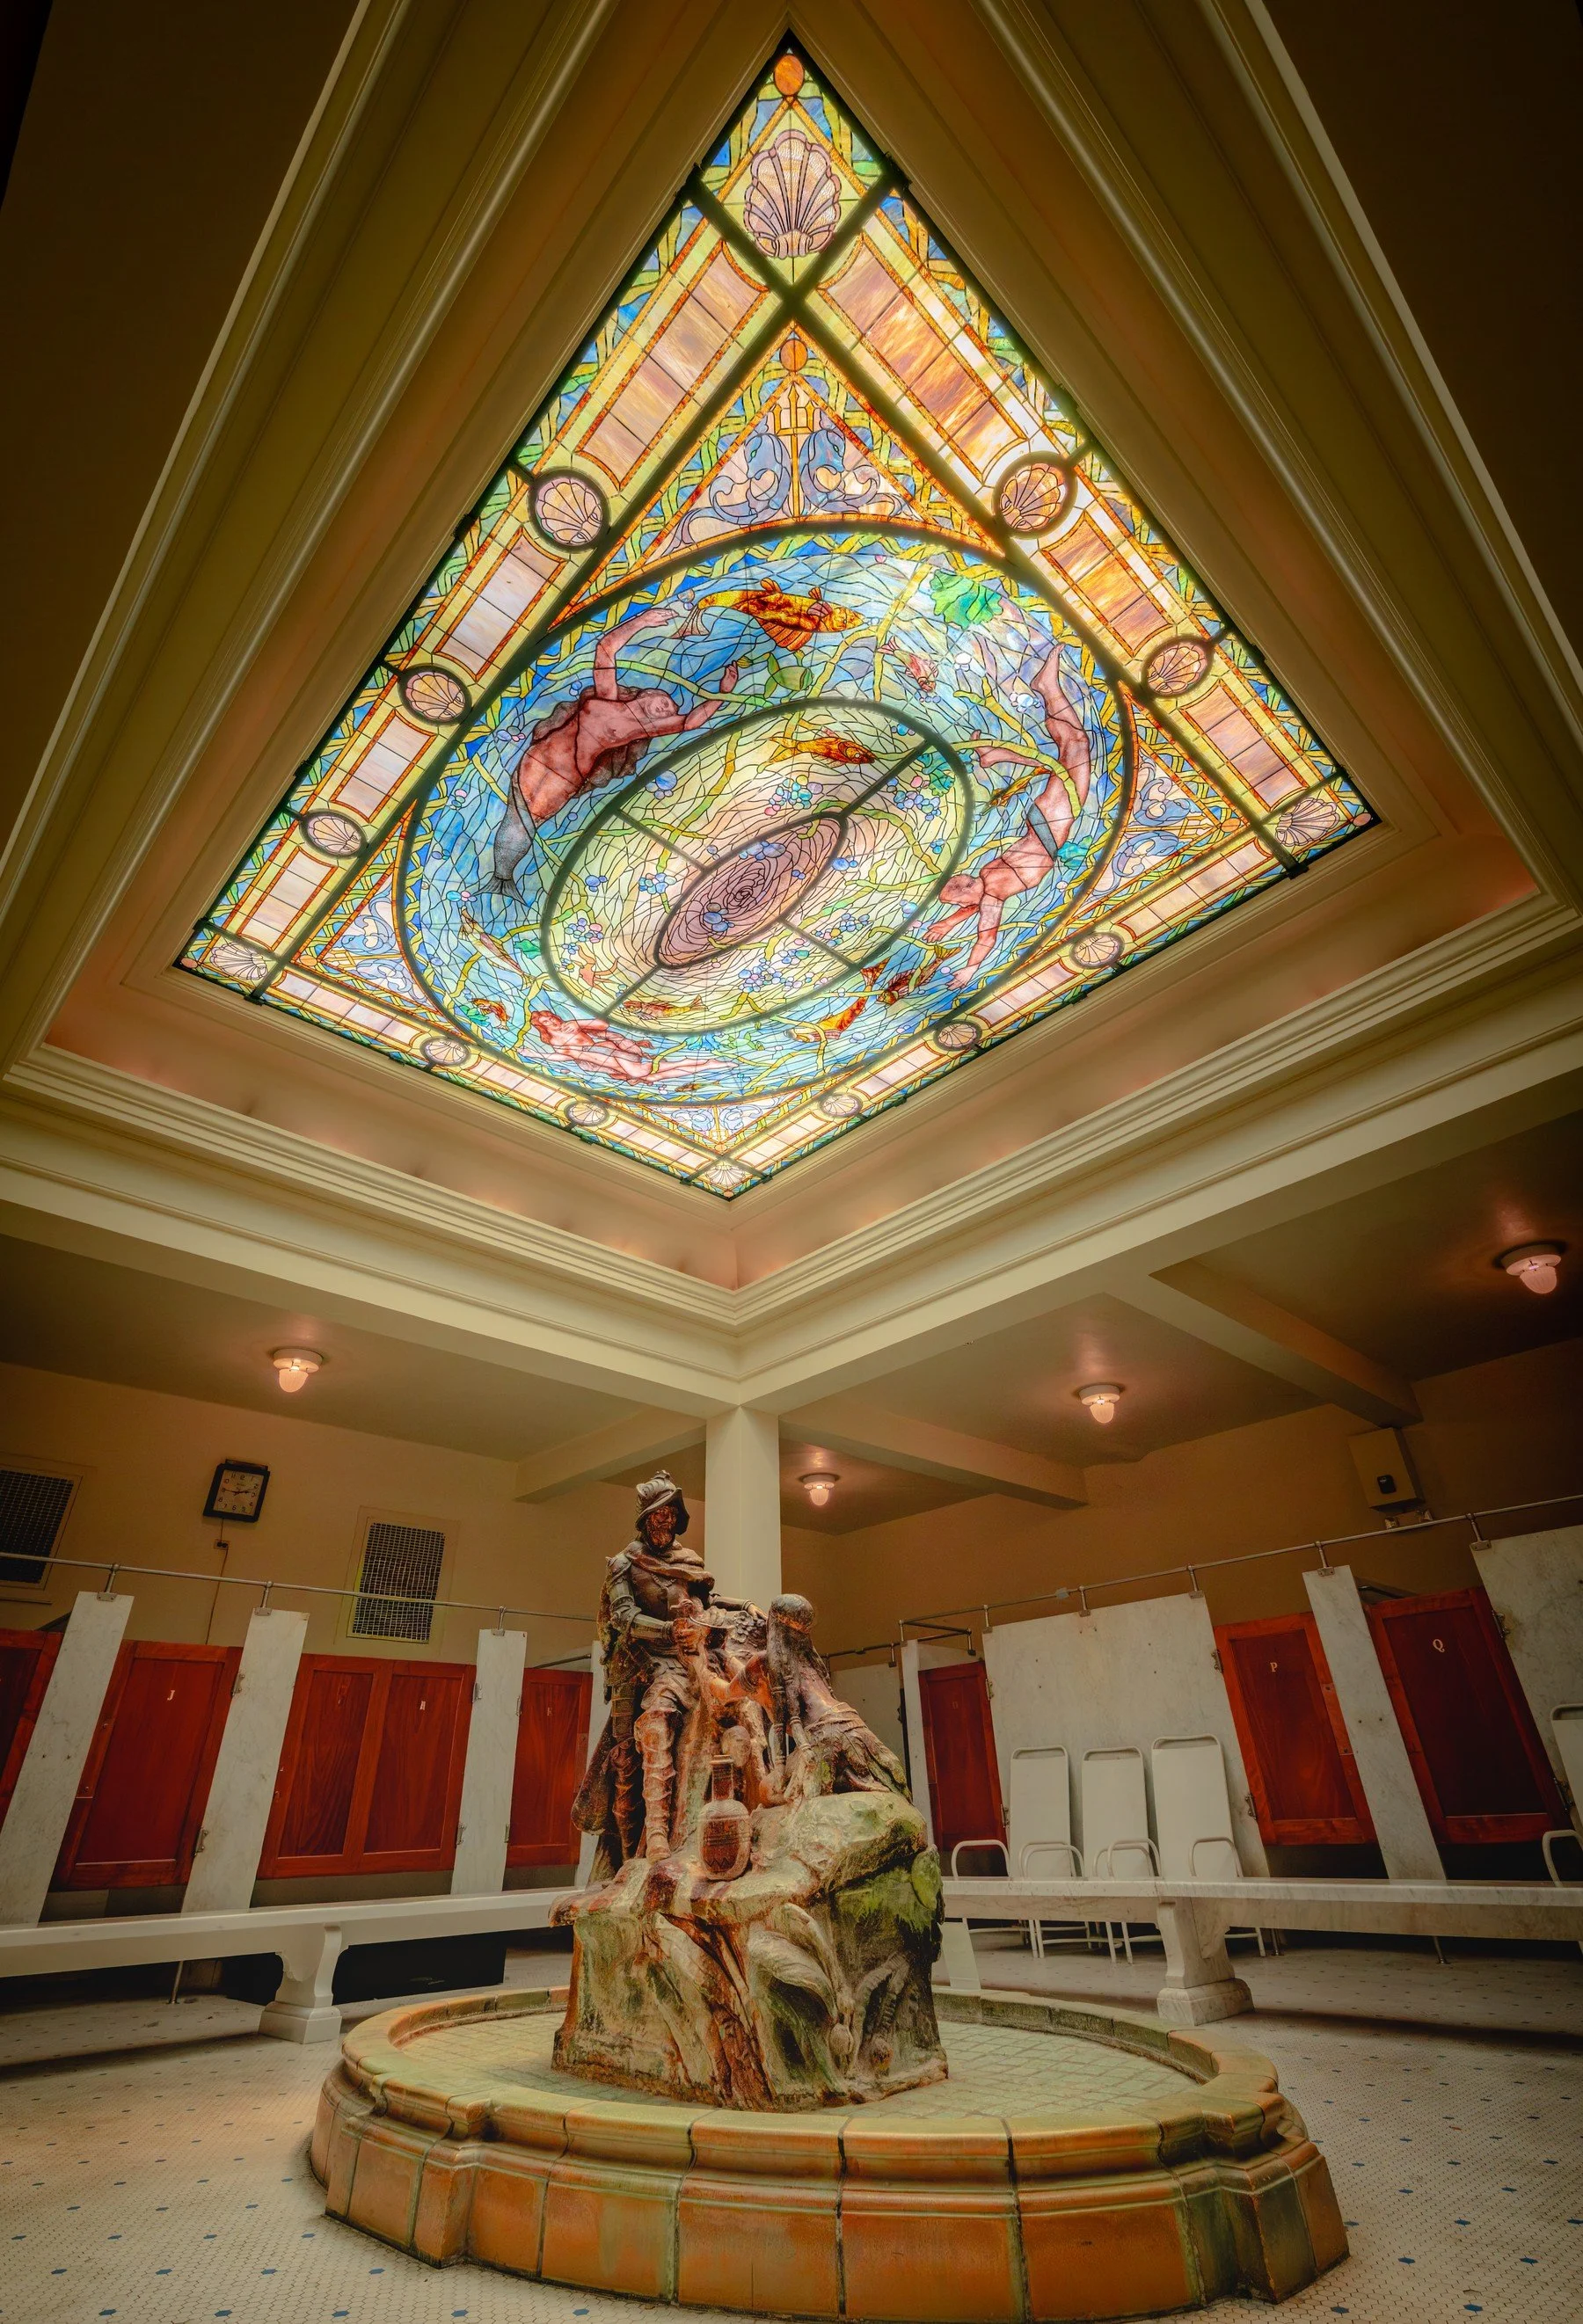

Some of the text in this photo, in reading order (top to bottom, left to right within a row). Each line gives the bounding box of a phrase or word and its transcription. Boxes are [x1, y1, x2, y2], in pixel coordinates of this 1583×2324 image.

[1433, 1638, 1445, 1652] Q
[1270, 1661, 1278, 1672] P
[167, 1689, 176, 1701] J
